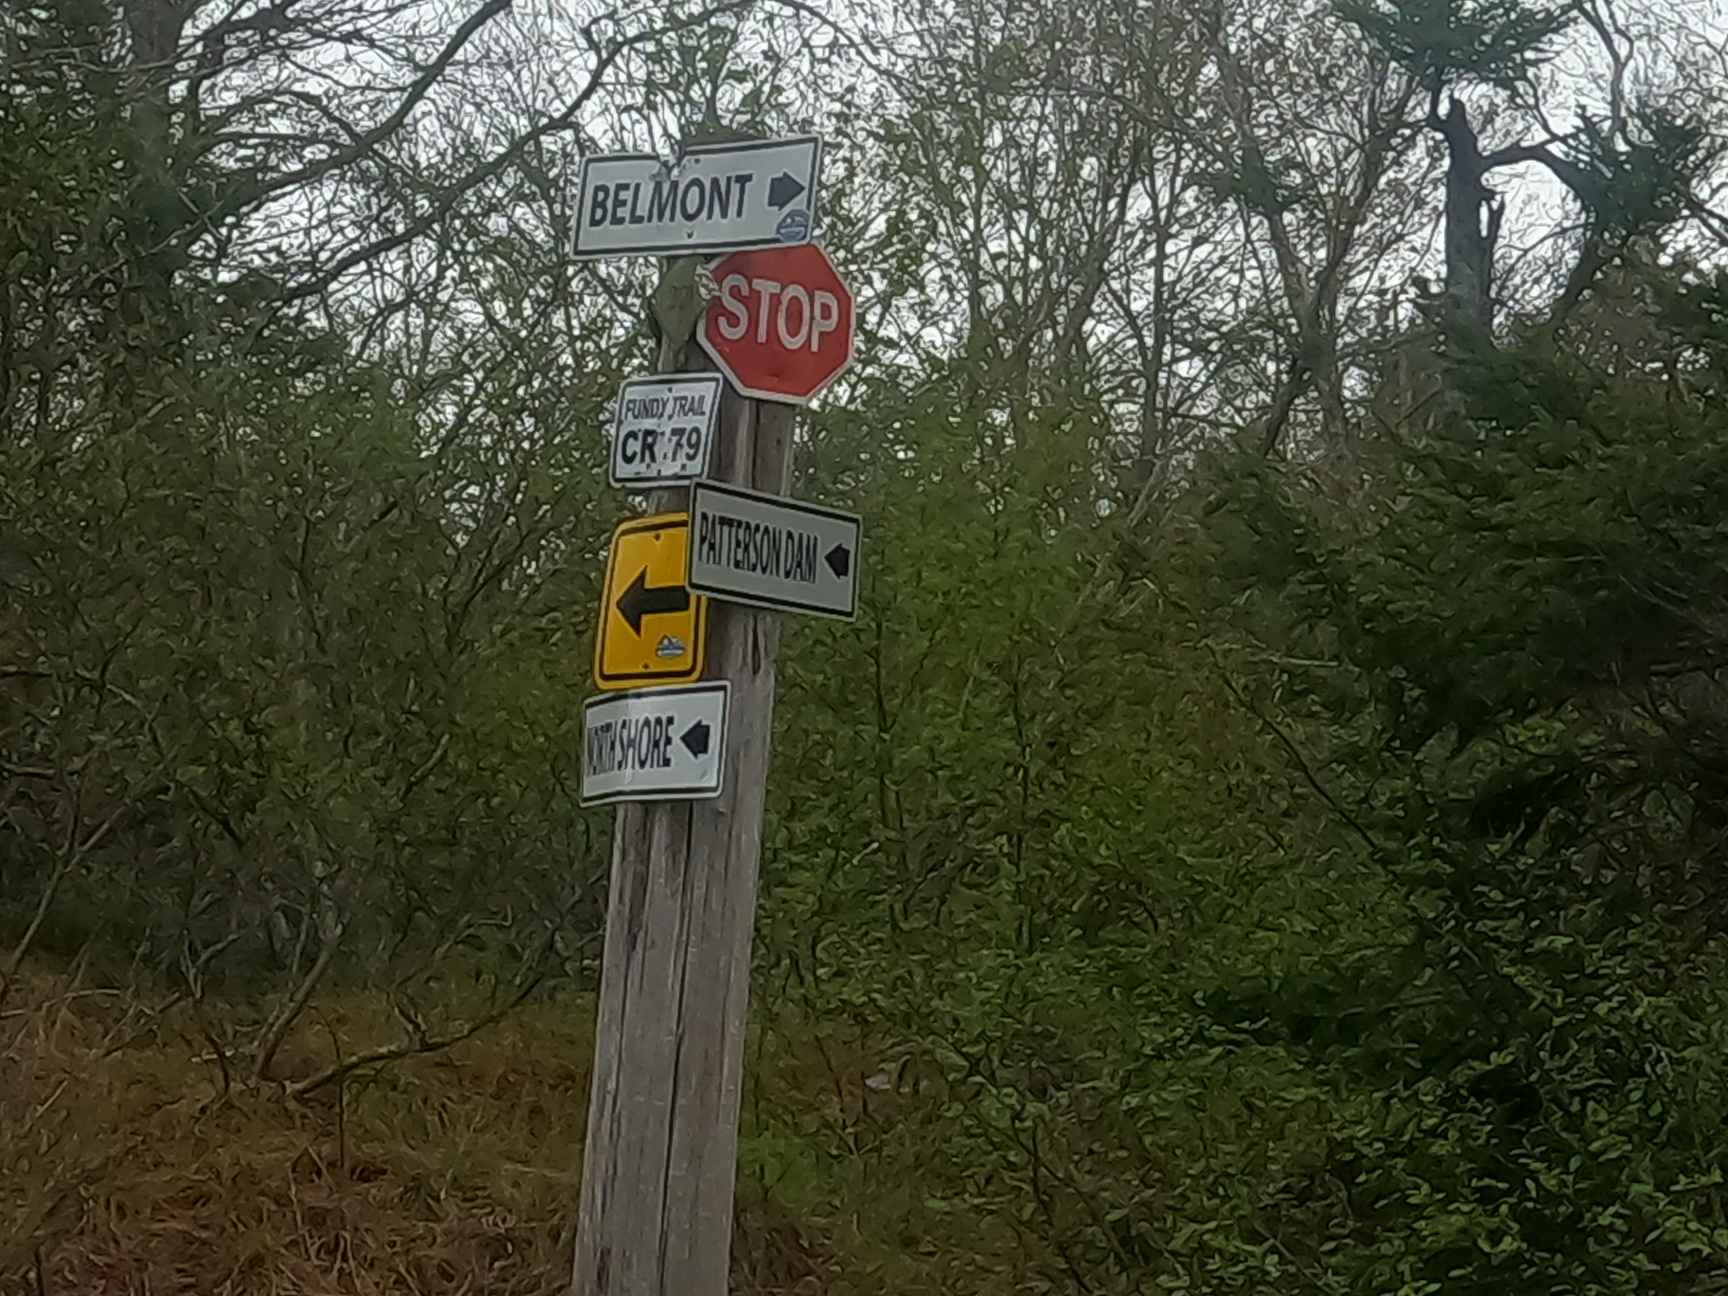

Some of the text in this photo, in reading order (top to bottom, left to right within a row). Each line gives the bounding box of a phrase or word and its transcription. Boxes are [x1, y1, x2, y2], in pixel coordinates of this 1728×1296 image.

[589, 173, 753, 227] BELMONT
[717, 273, 839, 353] STOP
[625, 395, 706, 420] FUNDY TRAIL
[698, 512, 818, 584] PATTERSON DAM
[617, 716, 674, 771] SHORE
